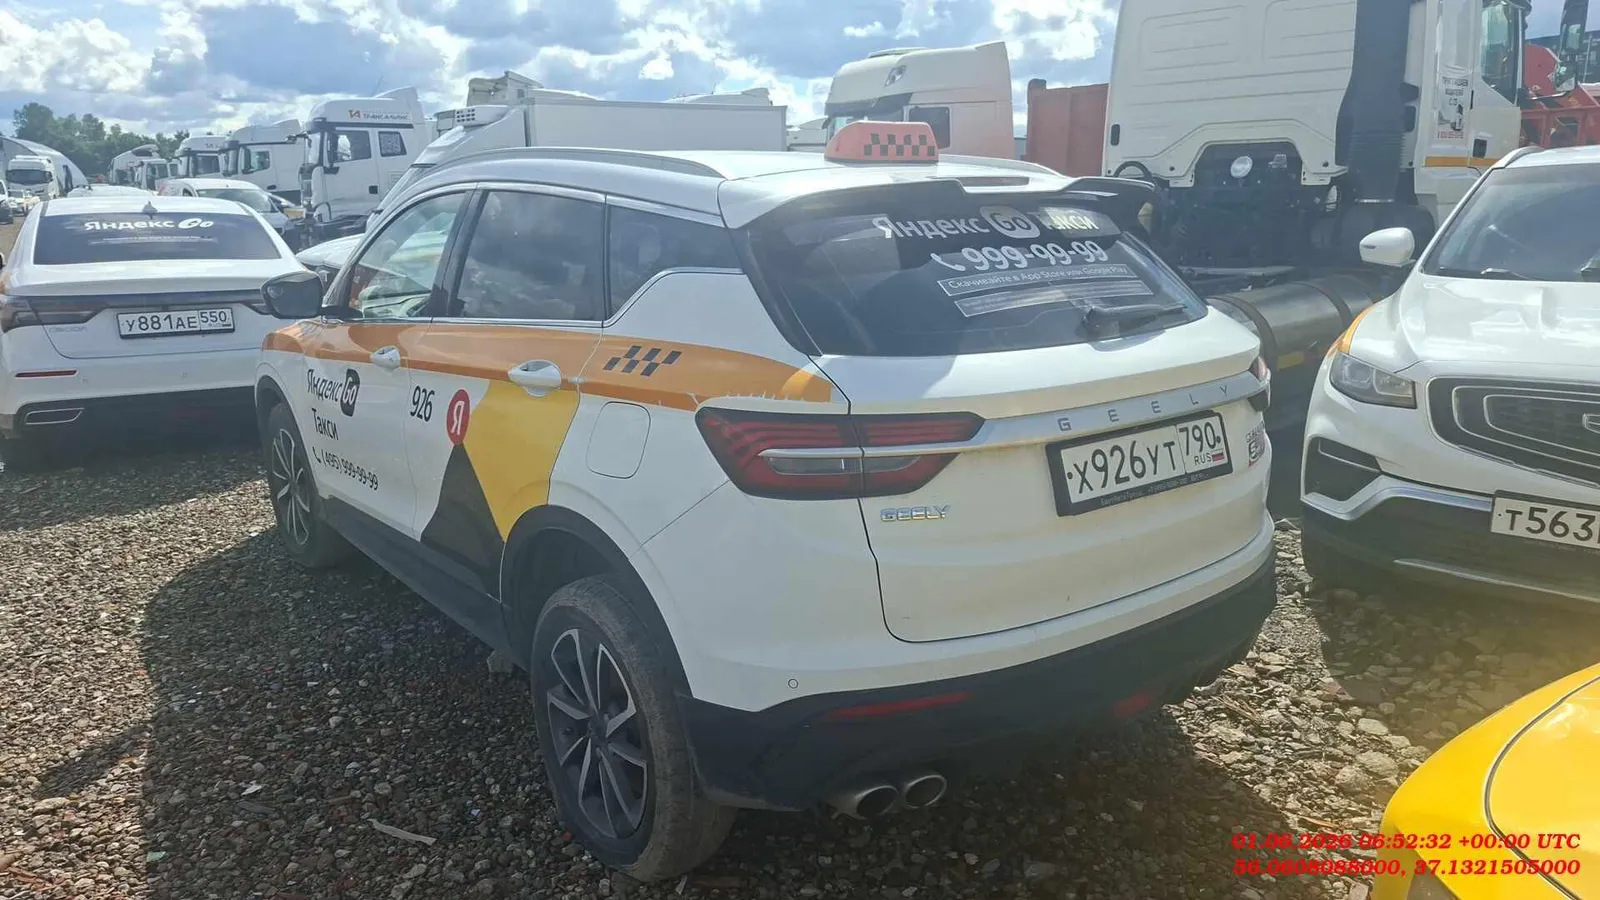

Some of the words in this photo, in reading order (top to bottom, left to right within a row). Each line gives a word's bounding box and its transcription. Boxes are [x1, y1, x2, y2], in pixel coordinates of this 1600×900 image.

[84, 220, 175, 231] Яндекс
[872, 216, 991, 239] Яндекс
[988, 212, 1033, 233] Go
[961, 240, 1109, 271] 999-99-99
[948, 275, 1012, 288] Скачивайте
[126, 314, 198, 332] У881АЕ
[200, 311, 227, 324] 550
[307, 369, 343, 402] Яндекс
[410, 385, 435, 422] 926
[451, 400, 465, 436] Я
[1057, 385, 1228, 432] GEELY
[311, 408, 338, 440] Такси
[1179, 421, 1216, 456] 790
[321, 449, 342, 474] (495)
[341, 458, 379, 491] 999-99-99
[1073, 440, 1176, 494] Х926УТ
[1194, 453, 1212, 466] RUS
[881, 504, 950, 522] GEELY
[1505, 506, 1600, 544] Т563
